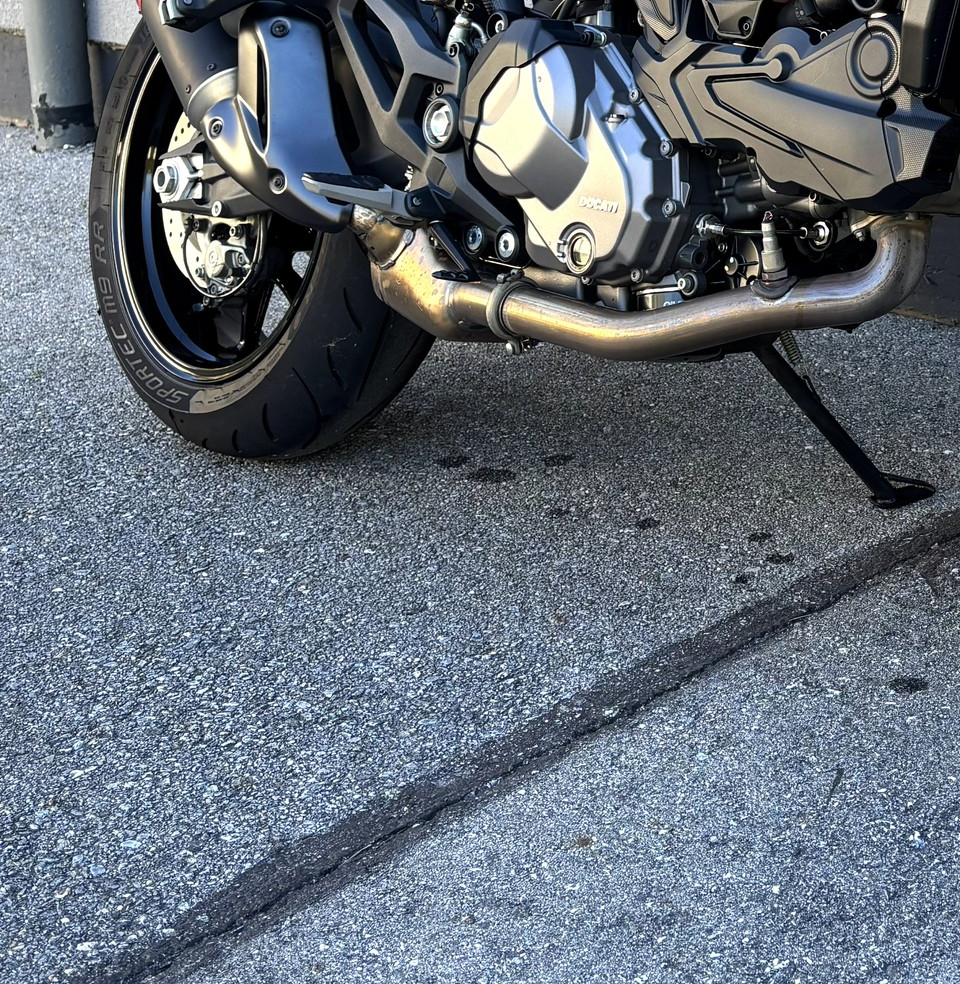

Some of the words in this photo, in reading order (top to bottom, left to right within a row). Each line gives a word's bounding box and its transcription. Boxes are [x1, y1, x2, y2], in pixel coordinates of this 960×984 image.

[578, 195, 619, 214] DUCATI
[93, 220, 106, 266] RR
[110, 322, 190, 404] SPORTEC
